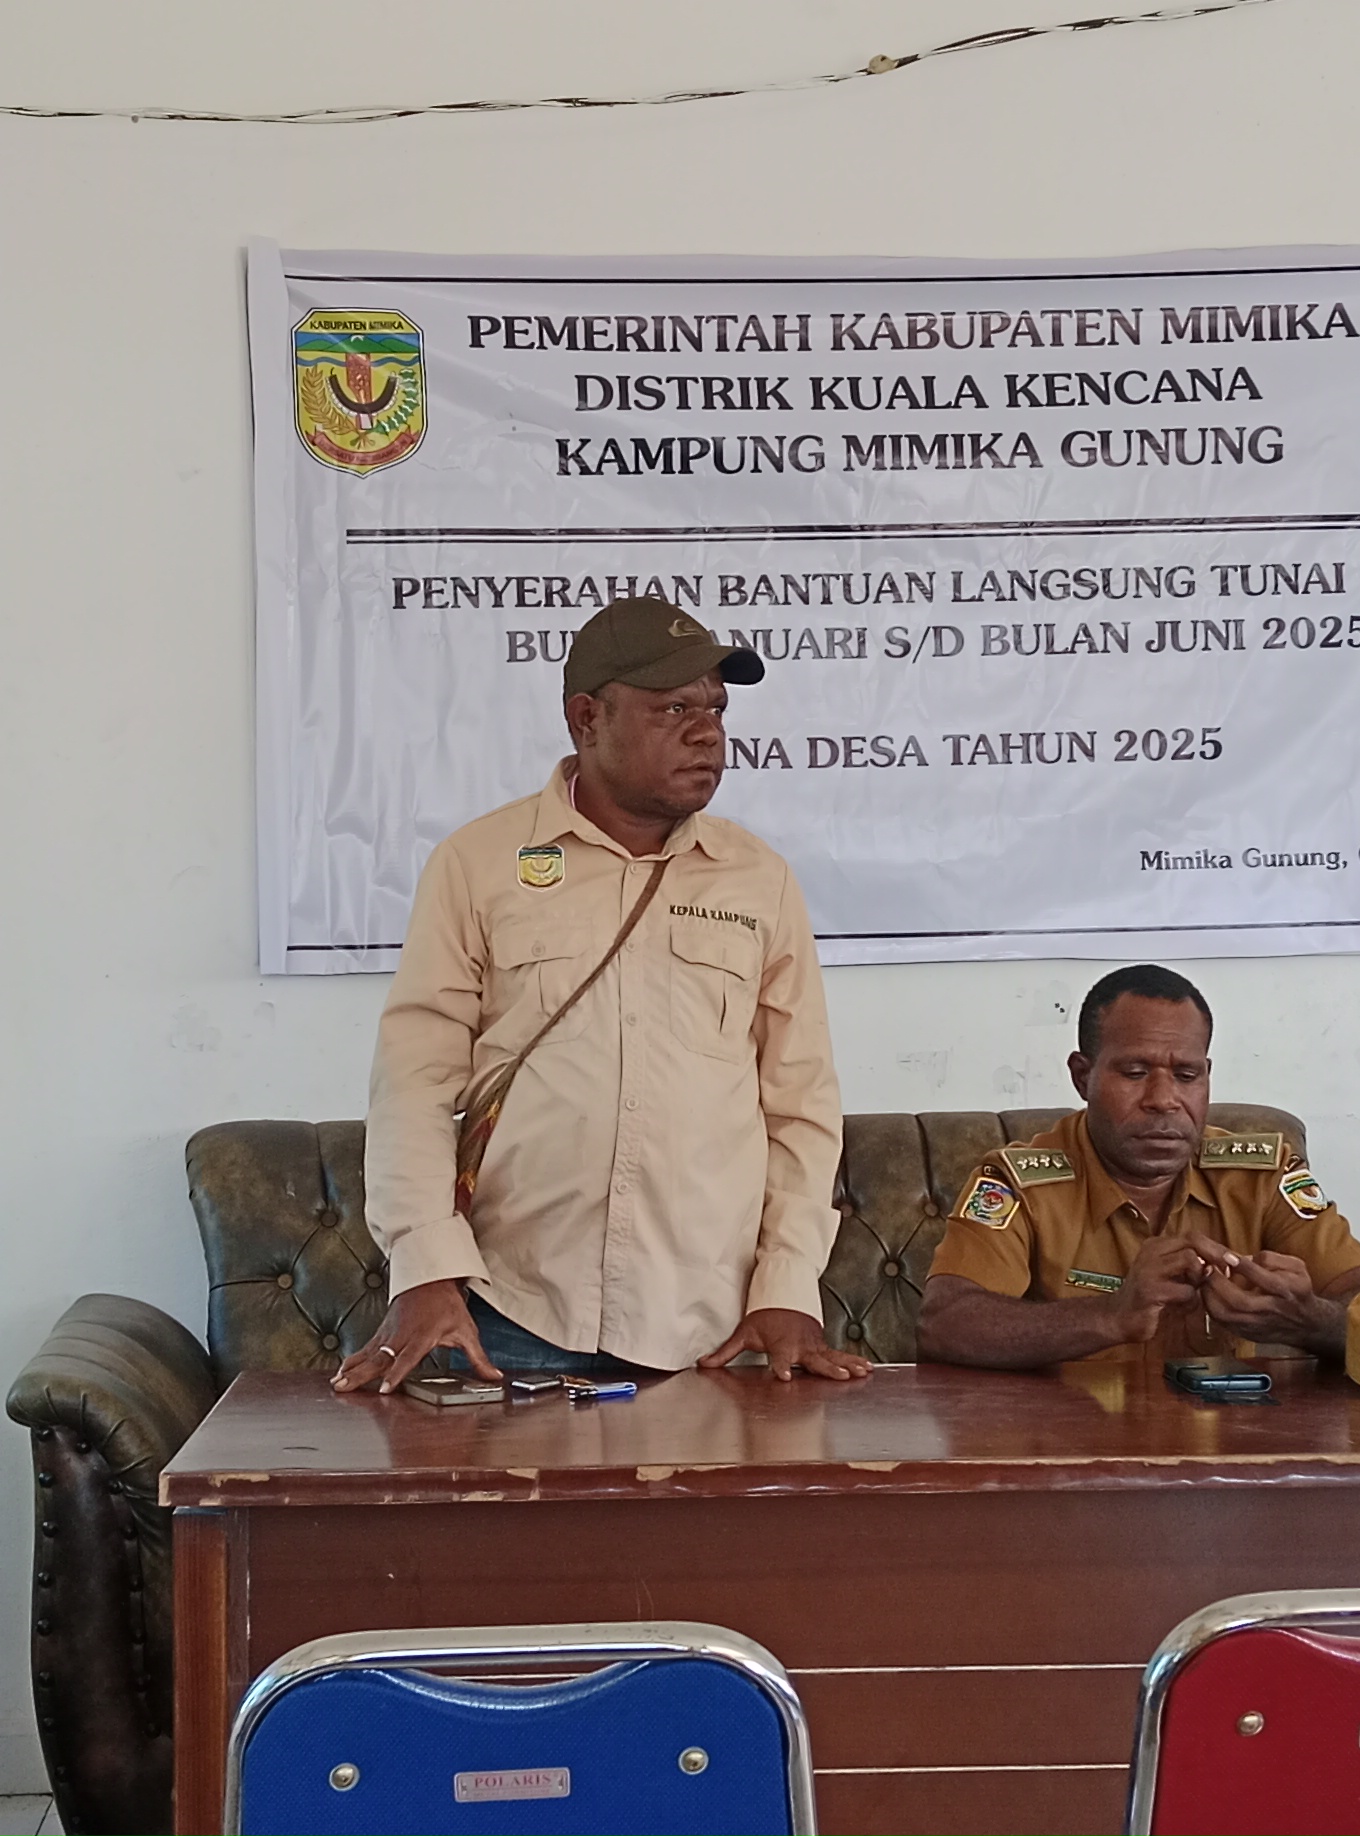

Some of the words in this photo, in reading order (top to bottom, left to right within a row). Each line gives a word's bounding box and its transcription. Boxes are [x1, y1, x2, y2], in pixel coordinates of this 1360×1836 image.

[310, 320, 367, 331] KABUPATEN
[468, 312, 812, 353] PEMERINTAH
[830, 308, 1143, 351] KABUPATEN
[1160, 302, 1360, 345] MIMIKA
[574, 374, 790, 412] DISTRIK
[811, 373, 989, 411] KUALA
[1005, 365, 1263, 409] KENCANA
[555, 434, 826, 477] KAMPUNG
[842, 430, 1044, 473] MIMIKA
[1060, 424, 1285, 467] GUNUNG
[393, 574, 703, 610] PENYERAHAN
[718, 570, 936, 607] BANTUAN
[951, 563, 1197, 603] LANGSUNG
[1211, 561, 1346, 598] TUNAI
[884, 624, 964, 664] S/D
[980, 620, 1131, 657] BULAN
[1144, 617, 1246, 655] JUNI
[724, 736, 793, 770] NA
[806, 733, 929, 769] DESA
[942, 730, 1097, 767] TAHUN
[1113, 726, 1224, 763] 2025
[1140, 848, 1233, 871] Mimika
[1242, 846, 1348, 872] Gunung,
[669, 905, 708, 919] KEPALA
[474, 1774, 552, 1788] POLARIS
